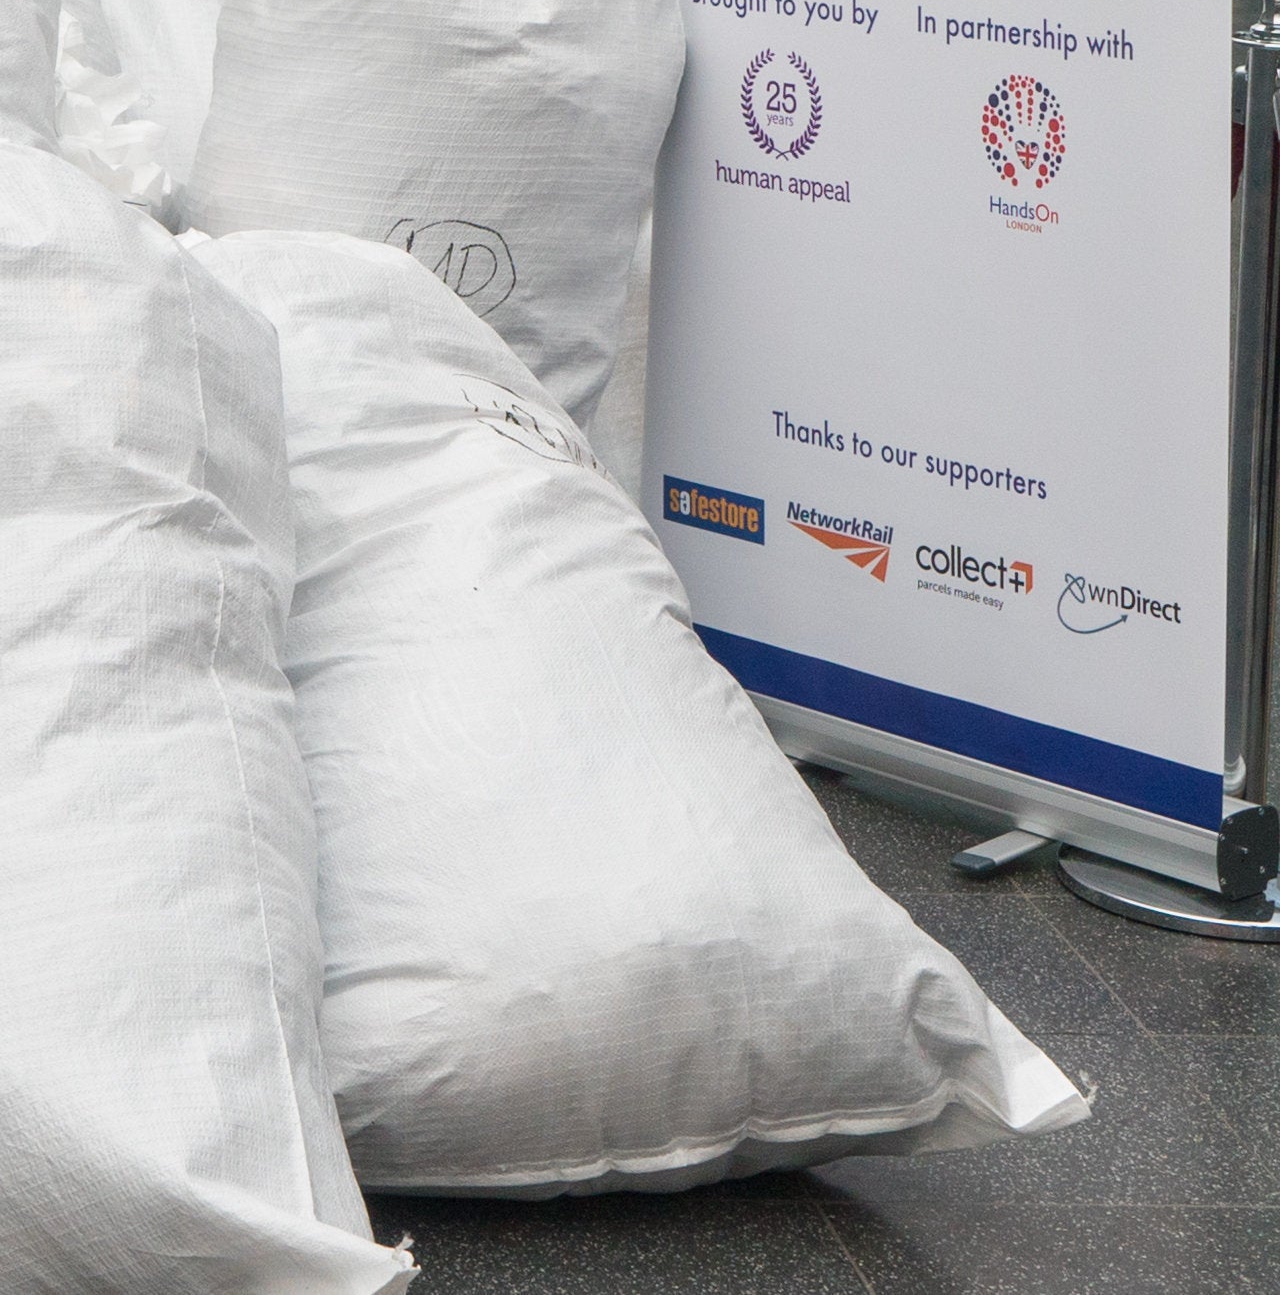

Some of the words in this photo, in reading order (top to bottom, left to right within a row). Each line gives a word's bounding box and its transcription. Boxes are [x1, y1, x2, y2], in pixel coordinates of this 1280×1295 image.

[804, 1, 842, 26] you
[918, 6, 936, 34] In
[947, 18, 1077, 60] partnership
[1087, 29, 1133, 60] with
[766, 81, 797, 114] 25
[766, 113, 795, 127] years
[715, 159, 783, 191] human
[788, 178, 850, 203] appeal
[989, 196, 1059, 224] HandsOn
[1007, 219, 1045, 233] LONDON
[772, 411, 844, 451] Thanks
[853, 433, 872, 458] to
[881, 446, 917, 468] our
[926, 456, 1046, 499] supporters
[669, 487, 759, 533] safestore
[787, 502, 893, 545] NetworkRail
[917, 579, 952, 596] parcels
[953, 588, 981, 604] made
[981, 595, 1004, 610] easy
